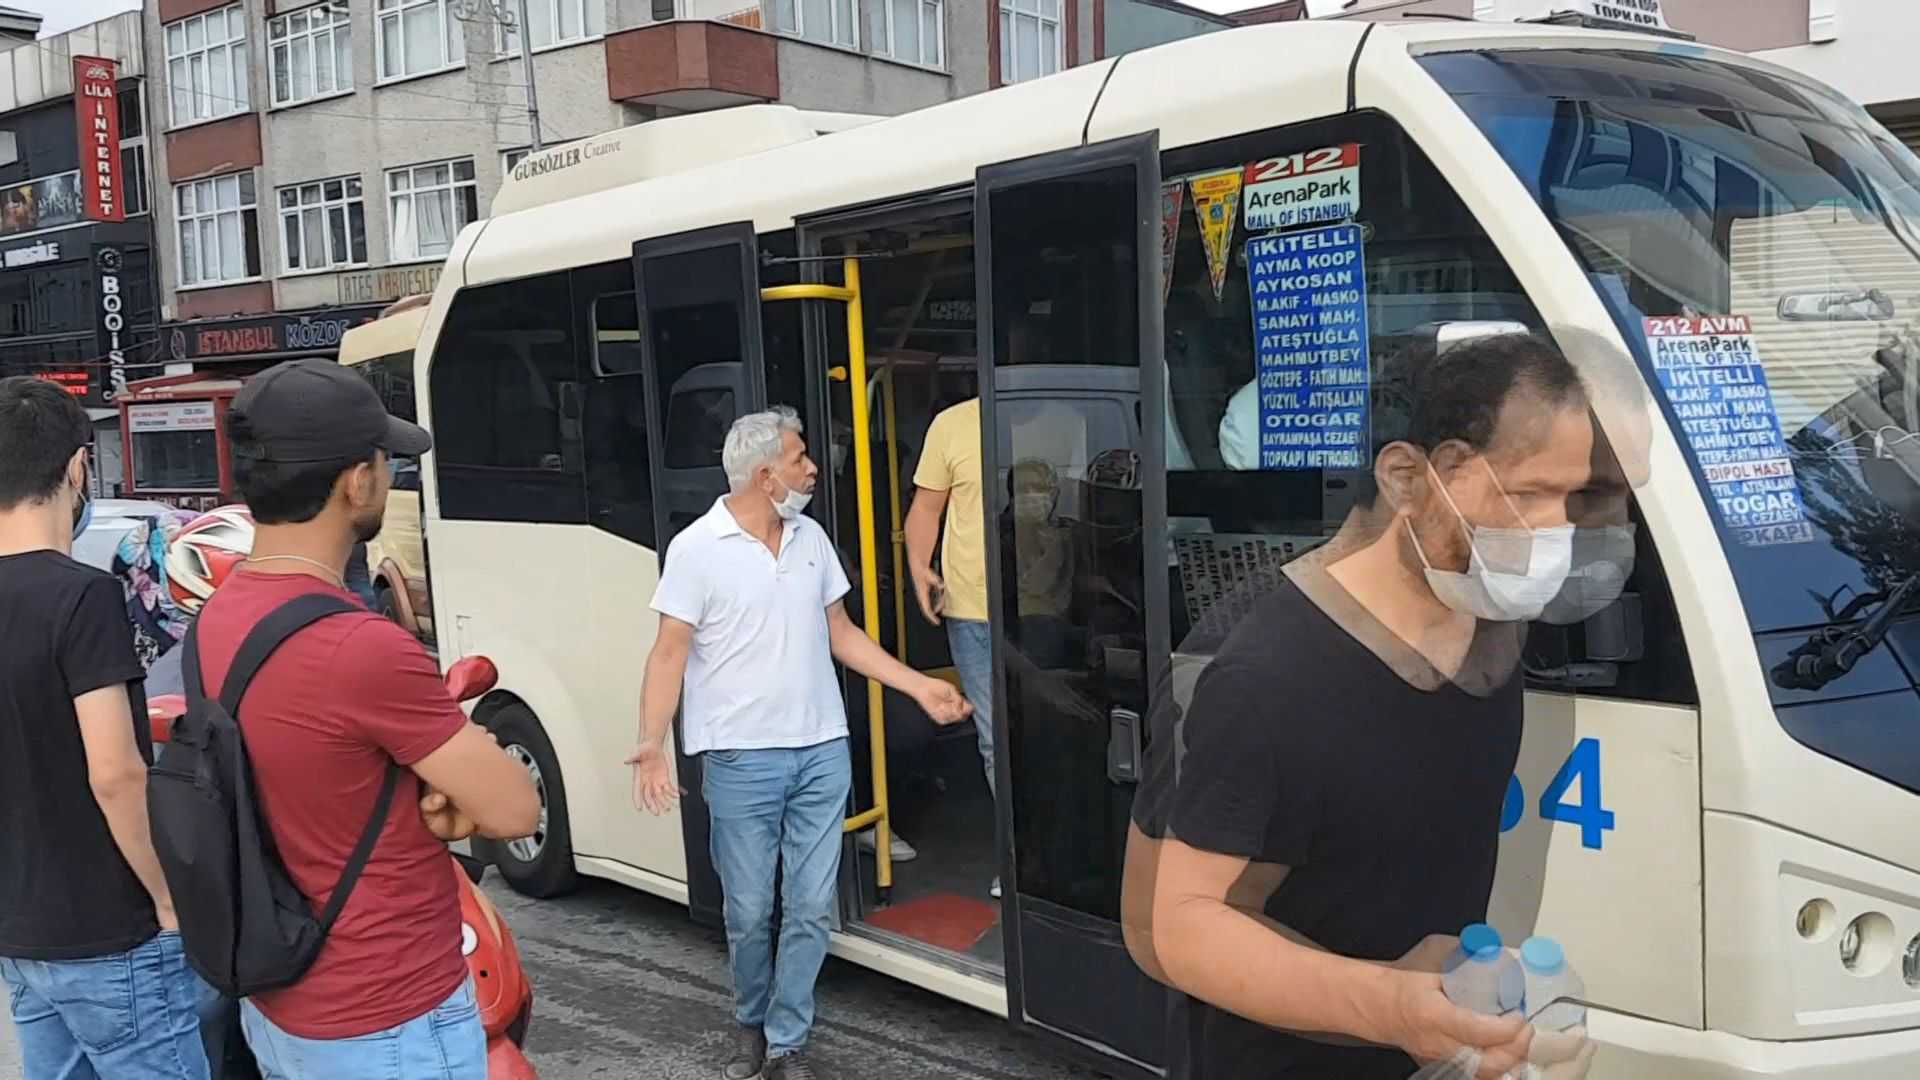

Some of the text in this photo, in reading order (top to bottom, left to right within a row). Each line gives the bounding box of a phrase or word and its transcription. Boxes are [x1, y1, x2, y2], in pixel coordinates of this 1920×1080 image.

[1592, 3, 1658, 27] TOPKAPI
[84, 82, 113, 97] LİLA
[94, 100, 113, 216] İNTERNET
[515, 148, 581, 181] GÜRSÖZLER
[1254, 147, 1344, 181] 212
[1249, 176, 1351, 210] ArenaPark
[1248, 214, 1276, 230] MALL
[1279, 210, 1294, 226] OF
[1253, 228, 1356, 257] İKİTELLİ
[1254, 250, 1357, 276] AYMA KOOP
[1256, 271, 1353, 294] AYKOSAN
[1311, 290, 1360, 307] MASKO
[1259, 310, 1361, 331] SANAYİ MAH.
[1650, 317, 1746, 336] 212 AVM
[1262, 328, 1360, 349] ATEŞTUĞLA
[1656, 336, 1751, 353] ArenaPark
[1262, 349, 1361, 367] MAHMUTBEY
[1656, 353, 1702, 368] MALL
[1704, 352, 1725, 365] OF
[1260, 370, 1303, 388] GÖZTEPE
[1722, 385, 1766, 399] MASKO
[1266, 412, 1361, 428] OTOGAR
[1263, 449, 1305, 467] TOPKAPI
